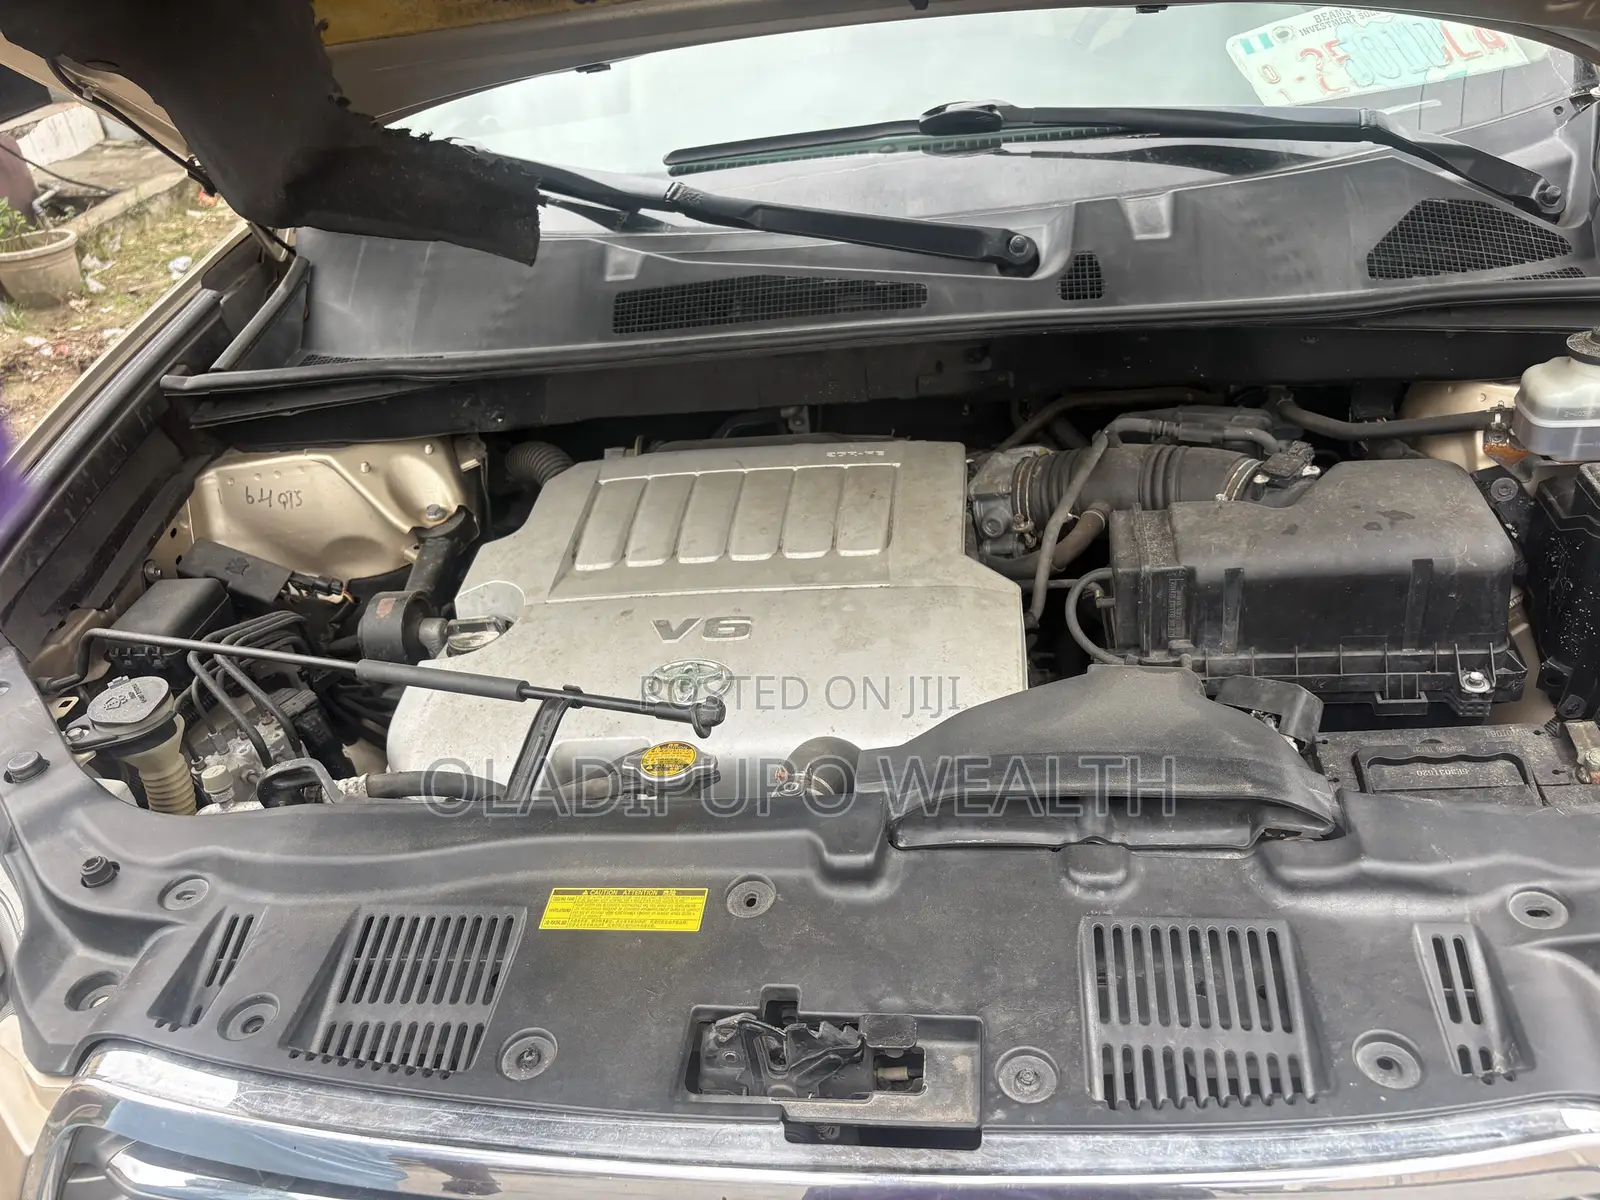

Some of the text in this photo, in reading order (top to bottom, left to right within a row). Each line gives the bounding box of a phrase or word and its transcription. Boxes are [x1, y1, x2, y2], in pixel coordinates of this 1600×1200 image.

[1298, 14, 1358, 37] INVESTMENT
[1313, 8, 1352, 24] BEAMS
[650, 615, 753, 644] V6
